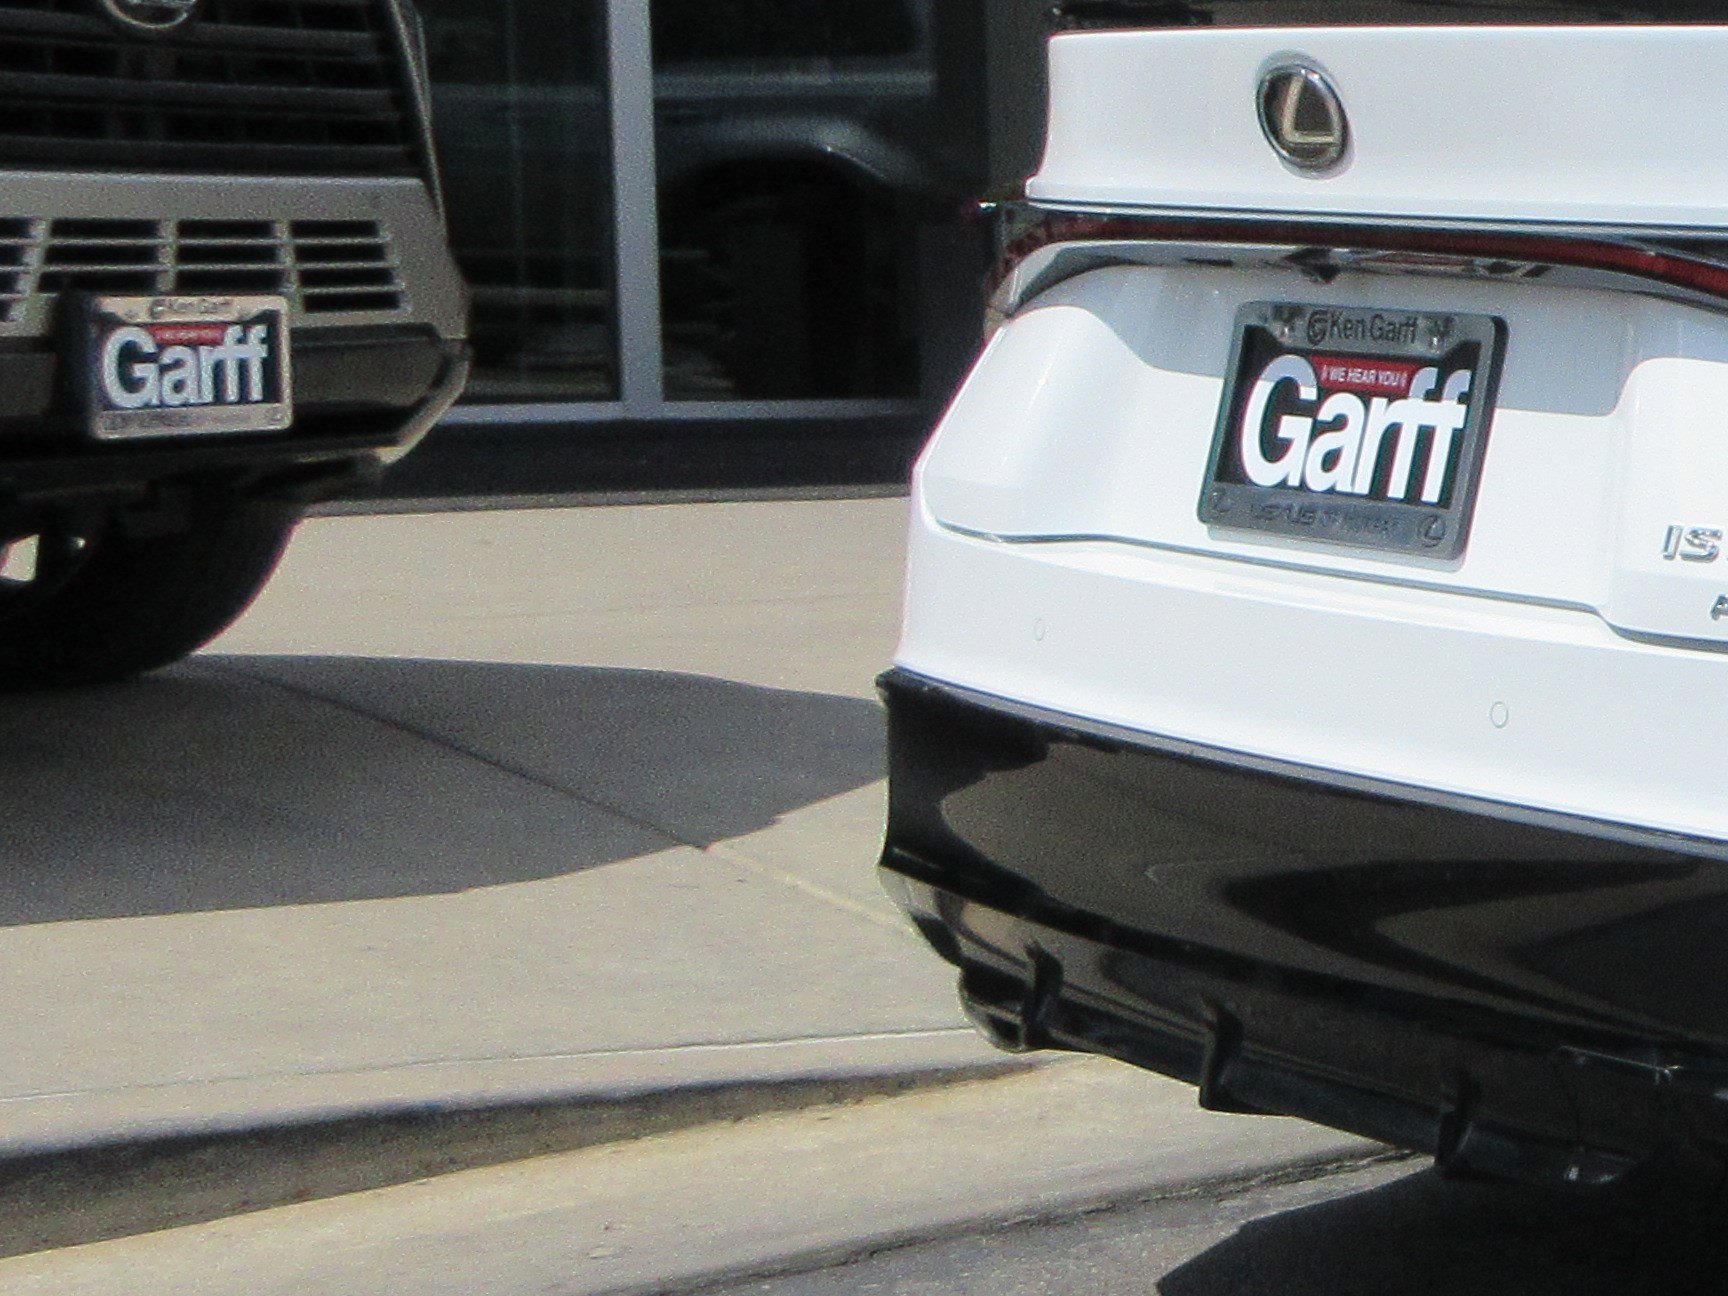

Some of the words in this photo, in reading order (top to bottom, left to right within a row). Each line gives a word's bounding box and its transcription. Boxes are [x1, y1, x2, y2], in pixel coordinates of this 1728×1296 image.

[1329, 310, 1366, 340] Ken
[103, 323, 269, 408] Garff
[1240, 353, 1472, 505] Garff
[1661, 524, 1723, 562] IS
